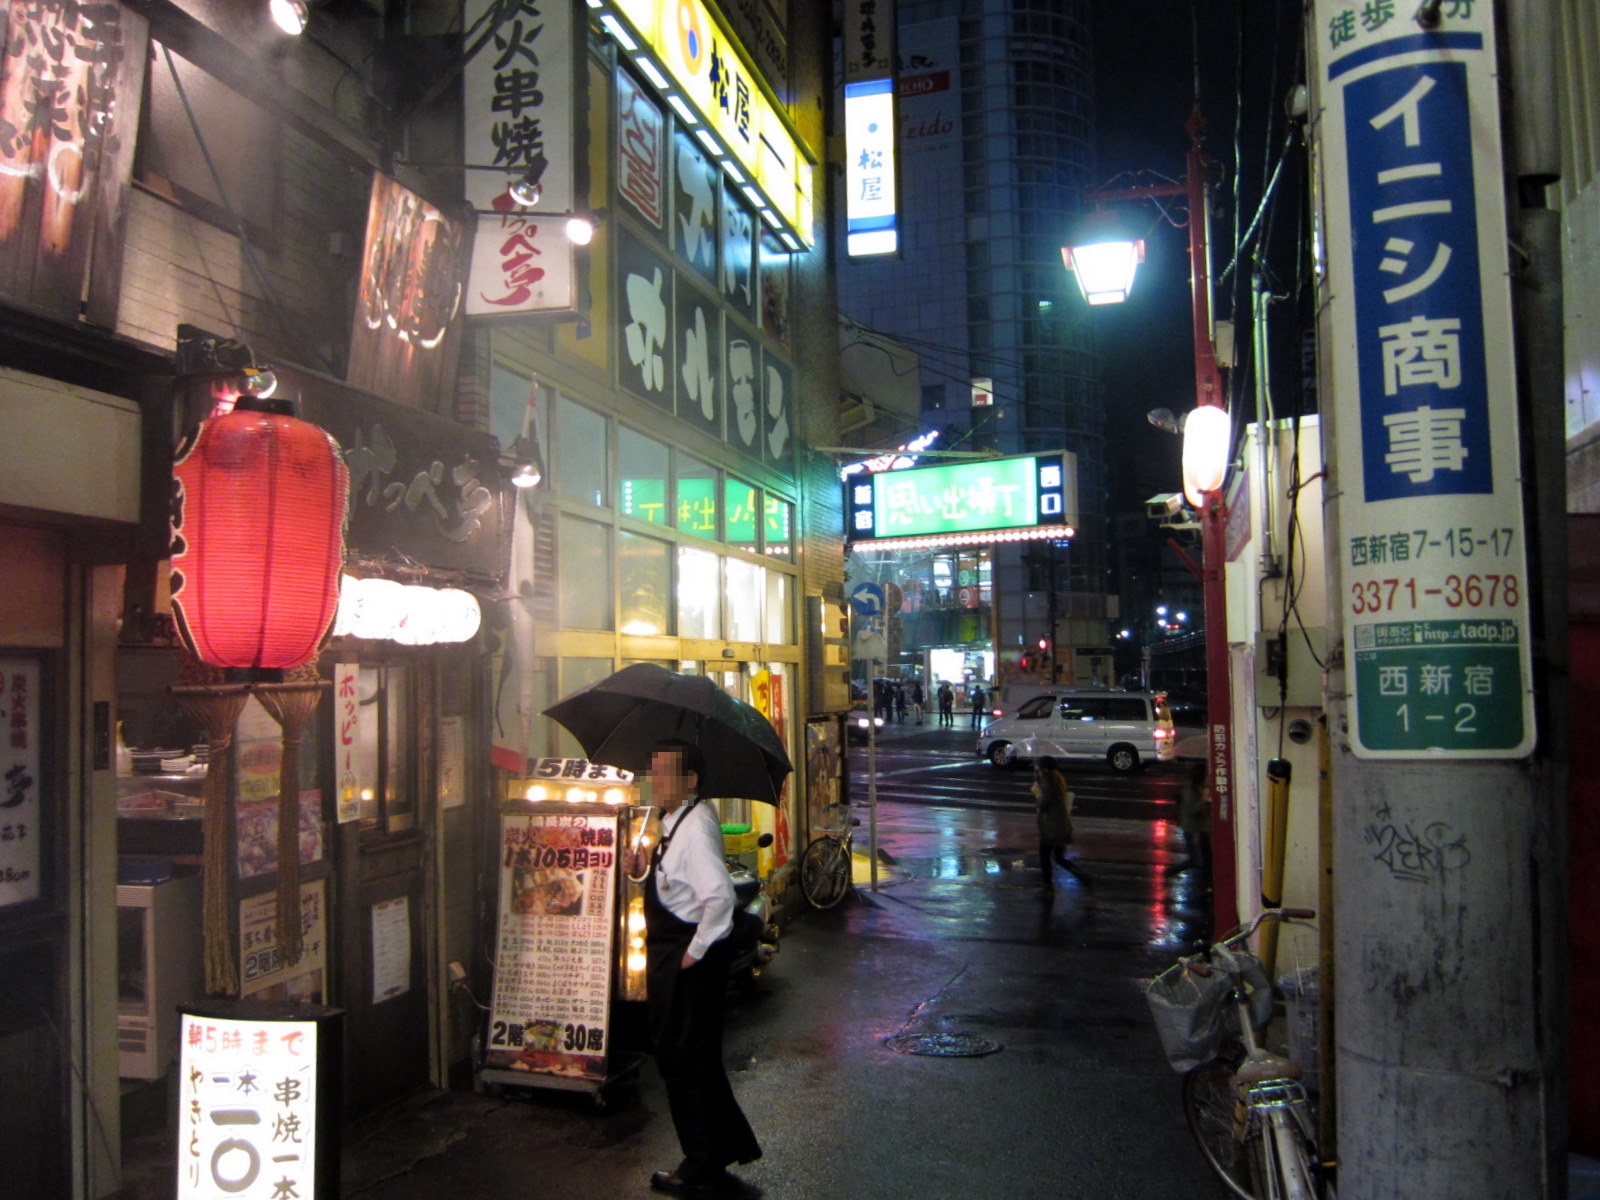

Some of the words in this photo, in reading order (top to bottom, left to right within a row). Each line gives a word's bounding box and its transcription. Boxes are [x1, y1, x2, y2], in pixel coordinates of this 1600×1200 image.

[1329, 0, 1473, 49] 徒歩分
[708, 37, 750, 145] 松屋
[858, 147, 884, 202] 松屋
[1368, 74, 1469, 484] イニシ商事
[1350, 527, 1515, 567] 西新宿7-15-17
[1351, 573, 1520, 615] 3371-3678
[1378, 663, 1494, 697] 西新宿
[527, 758, 634, 781] 5時ま
[492, 1020, 525, 1047] 2階
[564, 1023, 605, 1052] 30席
[212, 1069, 260, 1097] 一本
[189, 1065, 204, 1190] やきとり
[271, 1076, 304, 1200] 串焼一本
